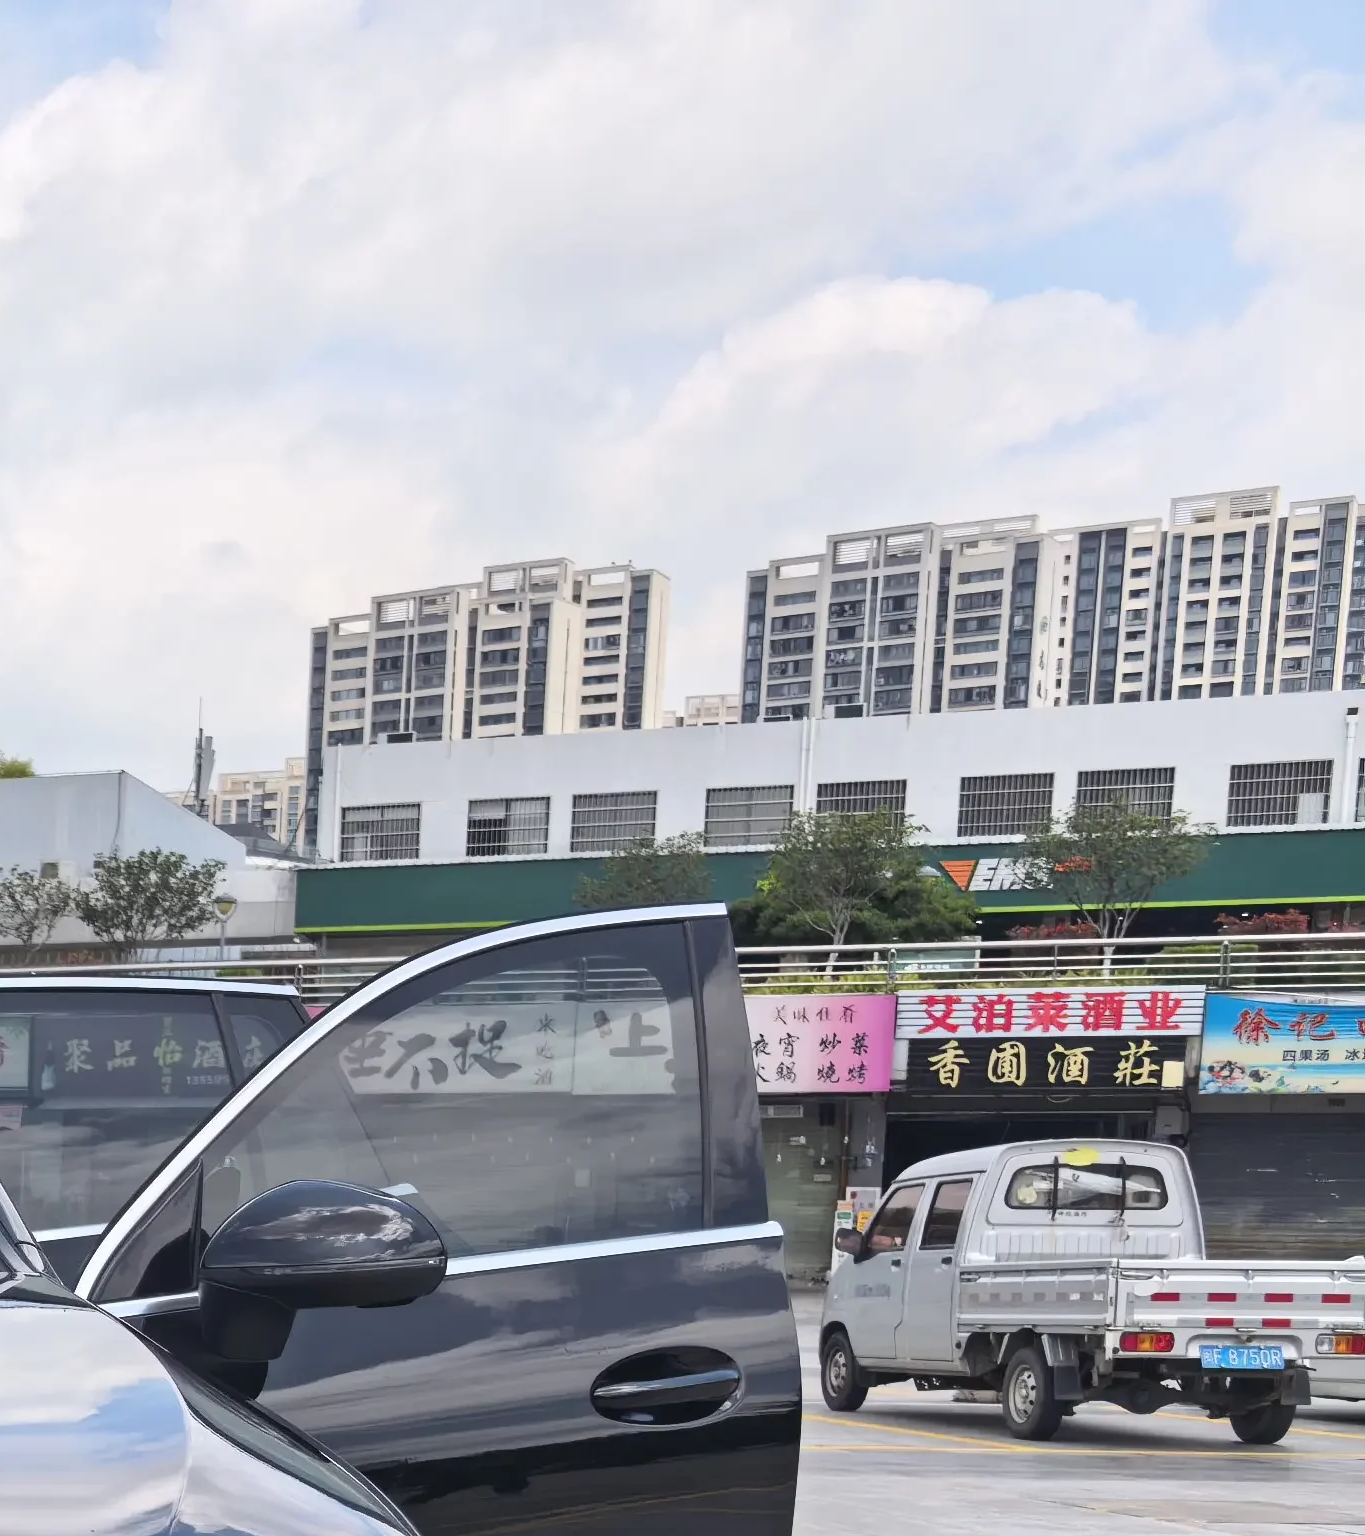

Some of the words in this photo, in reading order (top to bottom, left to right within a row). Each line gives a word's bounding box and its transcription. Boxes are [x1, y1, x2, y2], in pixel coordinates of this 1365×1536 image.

[918, 991, 1183, 1034] 艾泊莱酒业
[1233, 1007, 1365, 1046] 徐记
[1345, 1048, 1365, 1062] 冰
